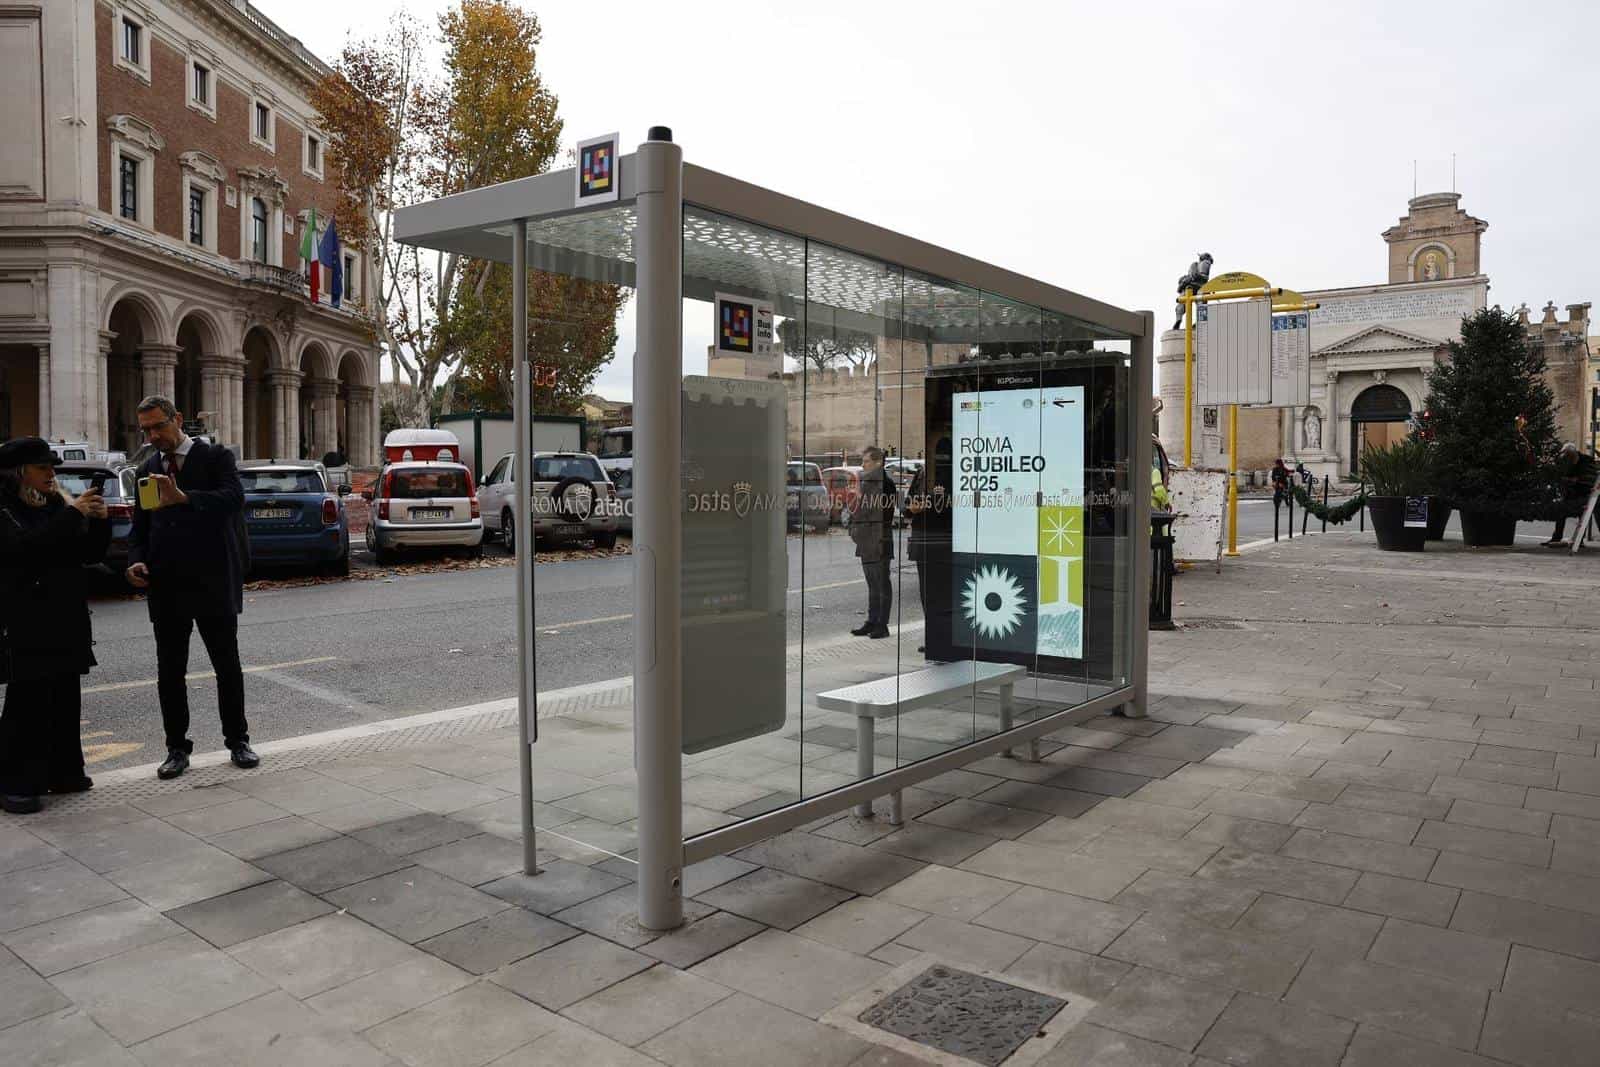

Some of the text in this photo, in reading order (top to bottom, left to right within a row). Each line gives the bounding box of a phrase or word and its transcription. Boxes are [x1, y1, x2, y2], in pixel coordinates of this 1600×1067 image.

[757, 319, 771, 329] Bus
[757, 328, 771, 339] info
[960, 436, 1013, 454] ROMA
[960, 455, 1046, 473] GIUBILEO
[960, 475, 998, 492] 2025
[531, 495, 633, 516] ROMA atac
